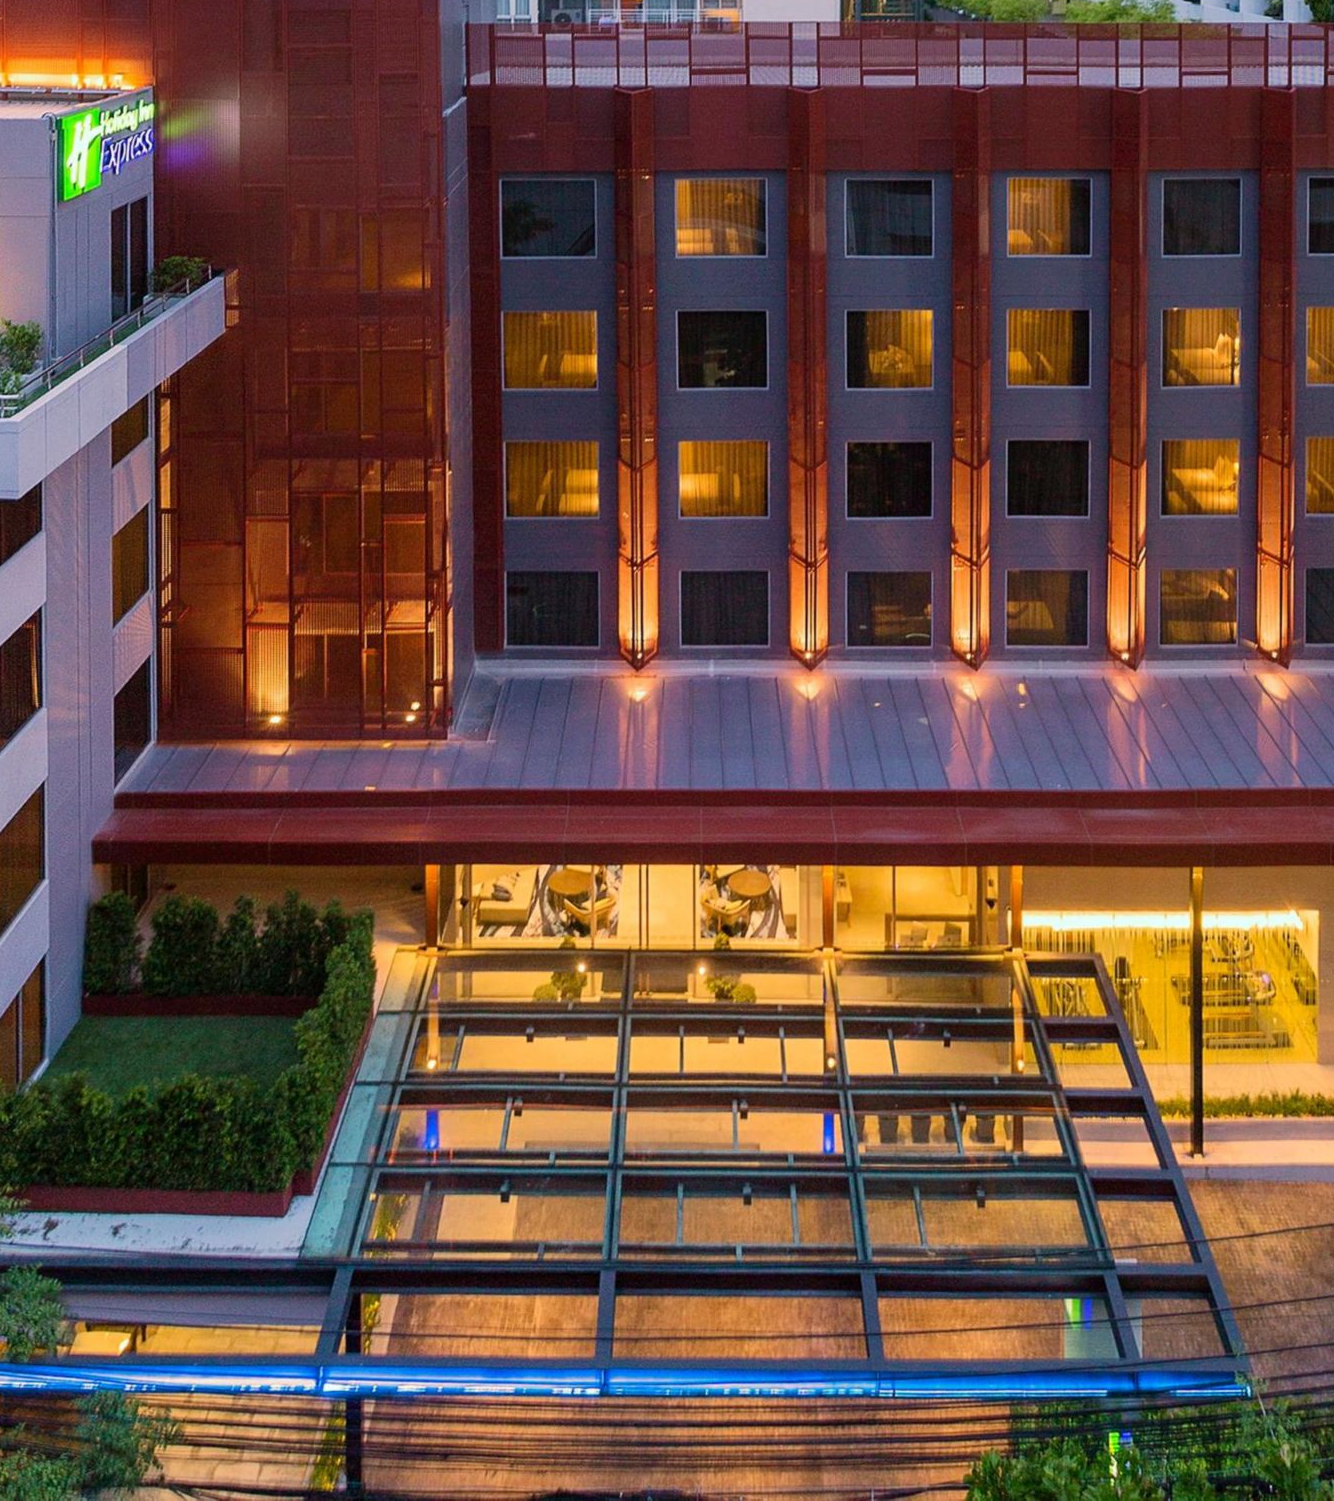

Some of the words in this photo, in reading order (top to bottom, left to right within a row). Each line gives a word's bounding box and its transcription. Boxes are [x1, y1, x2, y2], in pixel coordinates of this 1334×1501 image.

[99, 104, 138, 137] Holiday
[138, 99, 155, 123] Inn
[100, 128, 154, 175] Express
